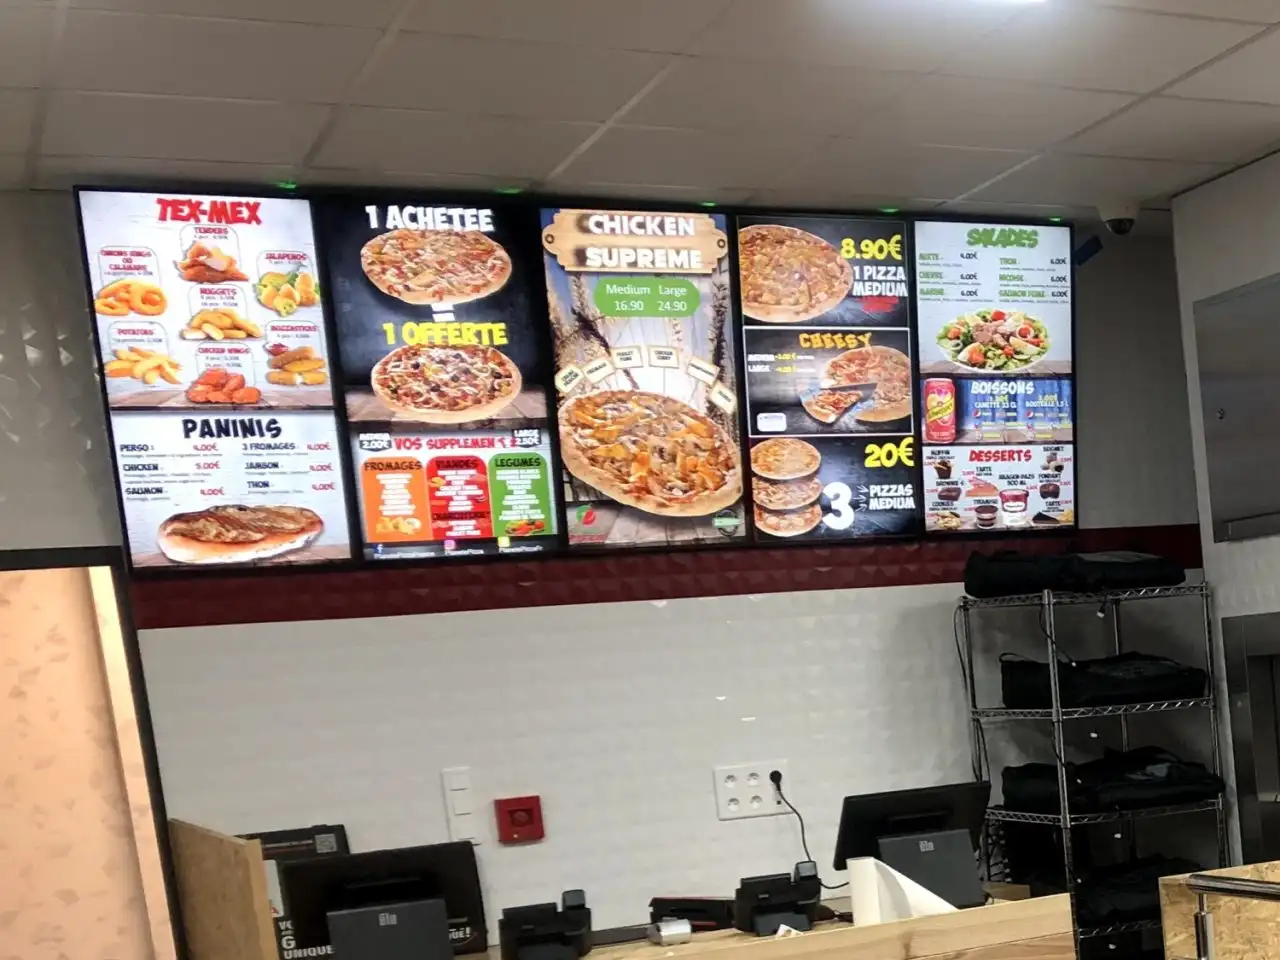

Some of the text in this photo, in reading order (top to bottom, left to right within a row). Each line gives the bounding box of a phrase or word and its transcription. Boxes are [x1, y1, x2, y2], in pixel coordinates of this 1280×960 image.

[157, 198, 262, 225] TEX-MEX
[365, 205, 496, 232] 1 ACHETEE
[588, 215, 696, 237] CHICKEN
[966, 228, 1039, 248] SALADES
[841, 234, 903, 261] 8.90€
[585, 247, 704, 269] SUPREME
[853, 266, 907, 281] 1 PIZZA
[606, 284, 650, 295] Medium
[658, 285, 688, 298] Large
[852, 281, 909, 297] MEDIUM
[615, 300, 644, 311] 16.90
[658, 300, 687, 312] 24.90
[382, 322, 509, 346] 1 OFFERTE
[799, 332, 873, 349] CHEESY
[970, 381, 1035, 395] BOISSONS
[182, 418, 282, 440] PANINIS
[119, 444, 149, 452] PERSO
[249, 442, 296, 451] FROMAGES
[394, 437, 422, 450] VOS
[864, 436, 915, 468] 20€
[968, 450, 1033, 462] DESSERTS
[123, 463, 159, 471] CHICKEN
[363, 461, 422, 471] FROMAGES
[495, 458, 542, 467] LEGUMES
[868, 484, 914, 498] PIZZAS
[822, 481, 855, 530] 3
[868, 497, 916, 511] MEDIUM
[284, 944, 334, 960] UNIQUE
